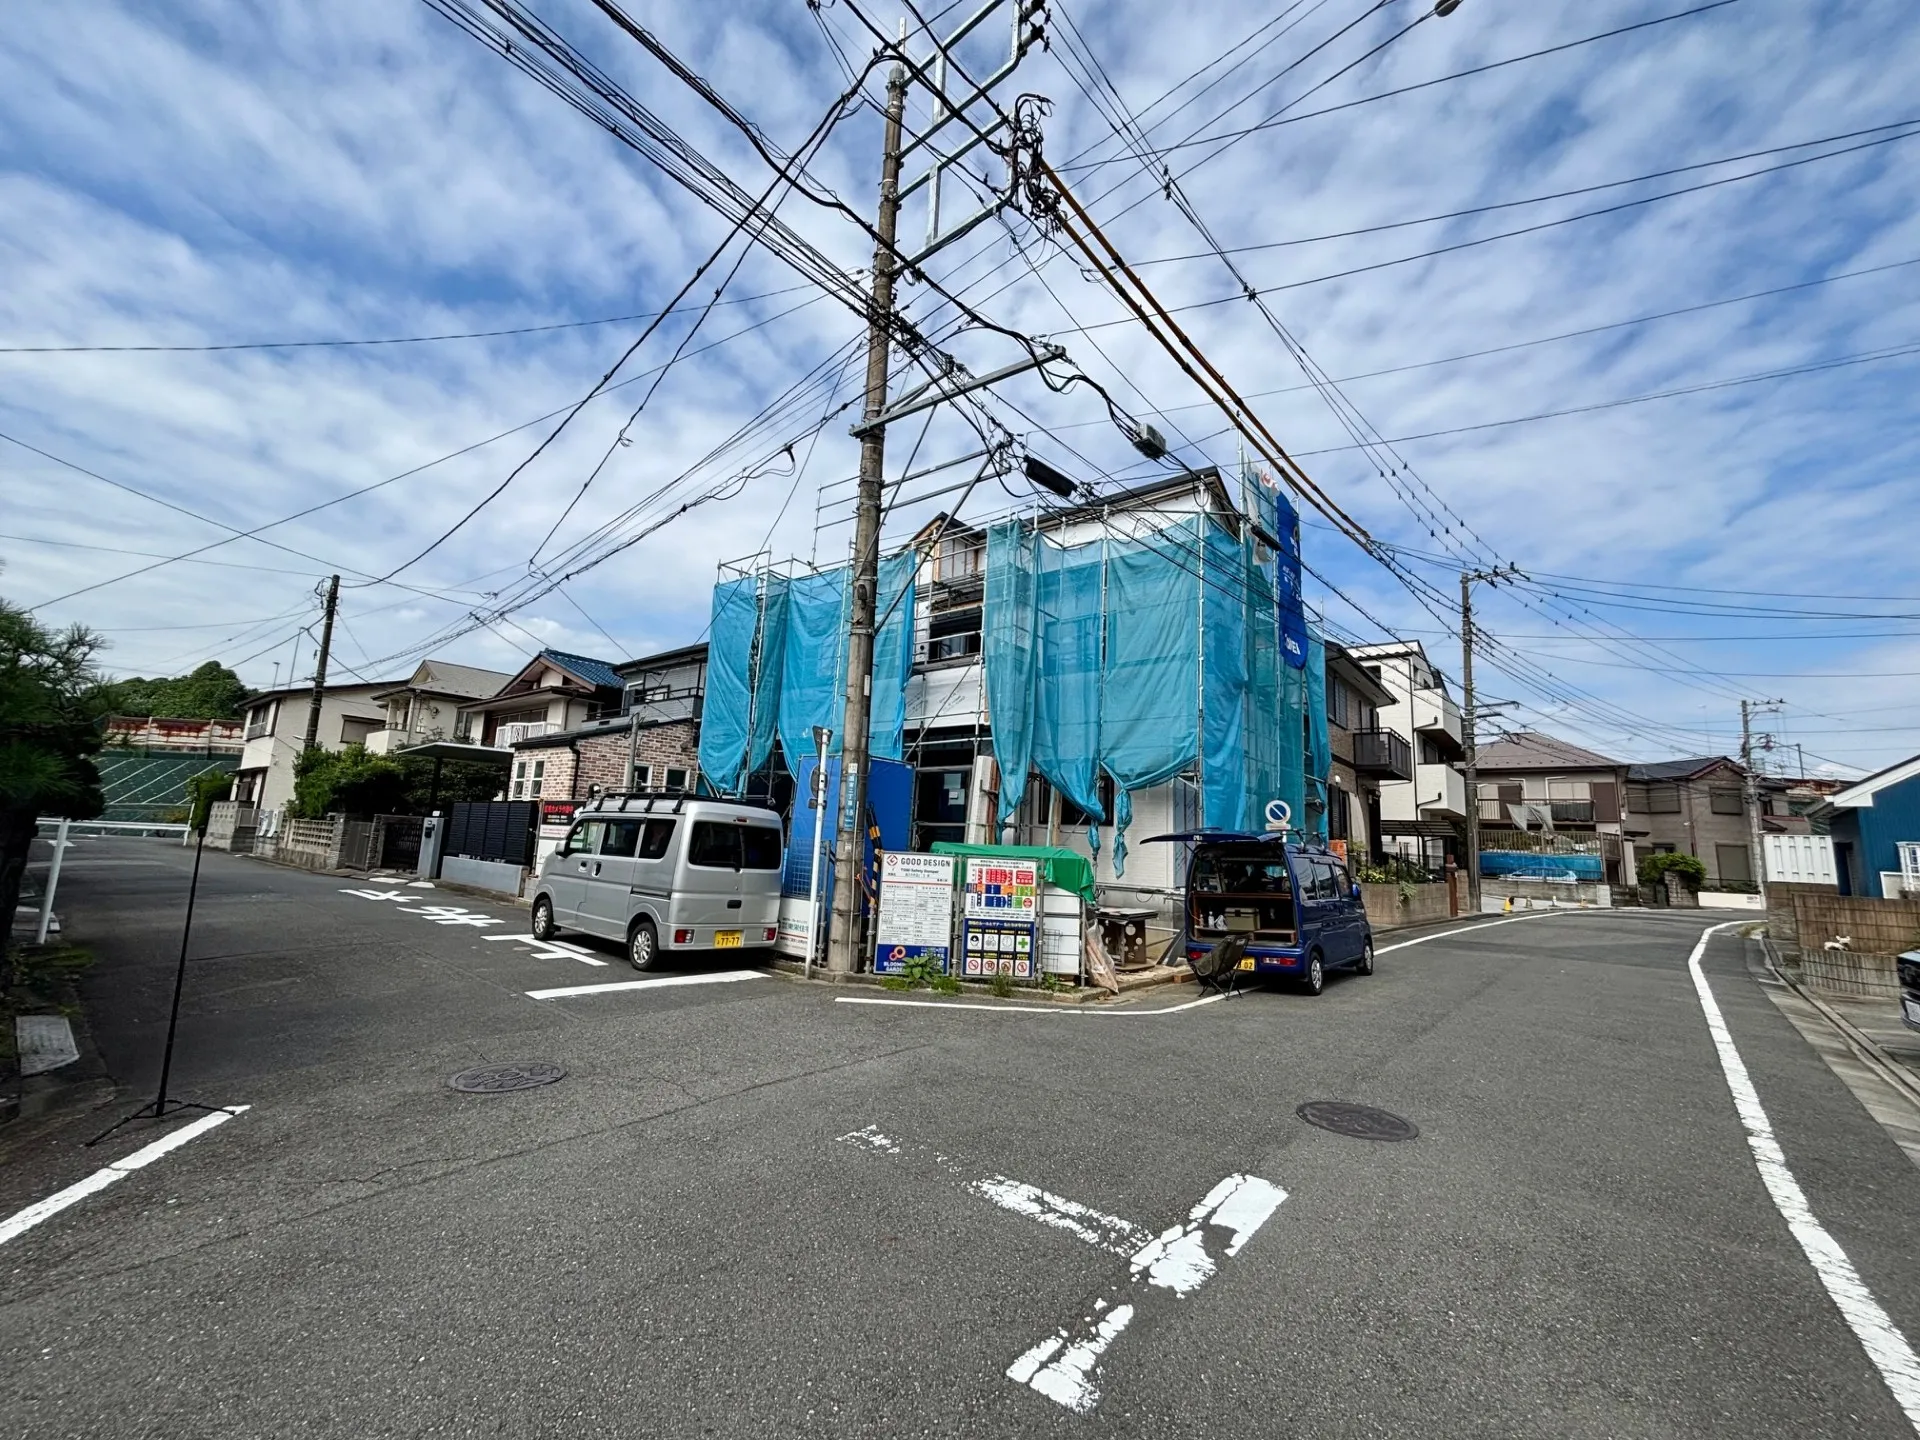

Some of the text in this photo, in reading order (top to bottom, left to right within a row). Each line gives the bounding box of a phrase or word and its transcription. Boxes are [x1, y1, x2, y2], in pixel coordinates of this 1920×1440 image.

[901, 857, 951, 867] GOOD DESIGN
[720, 937, 740, 946] 77-77
